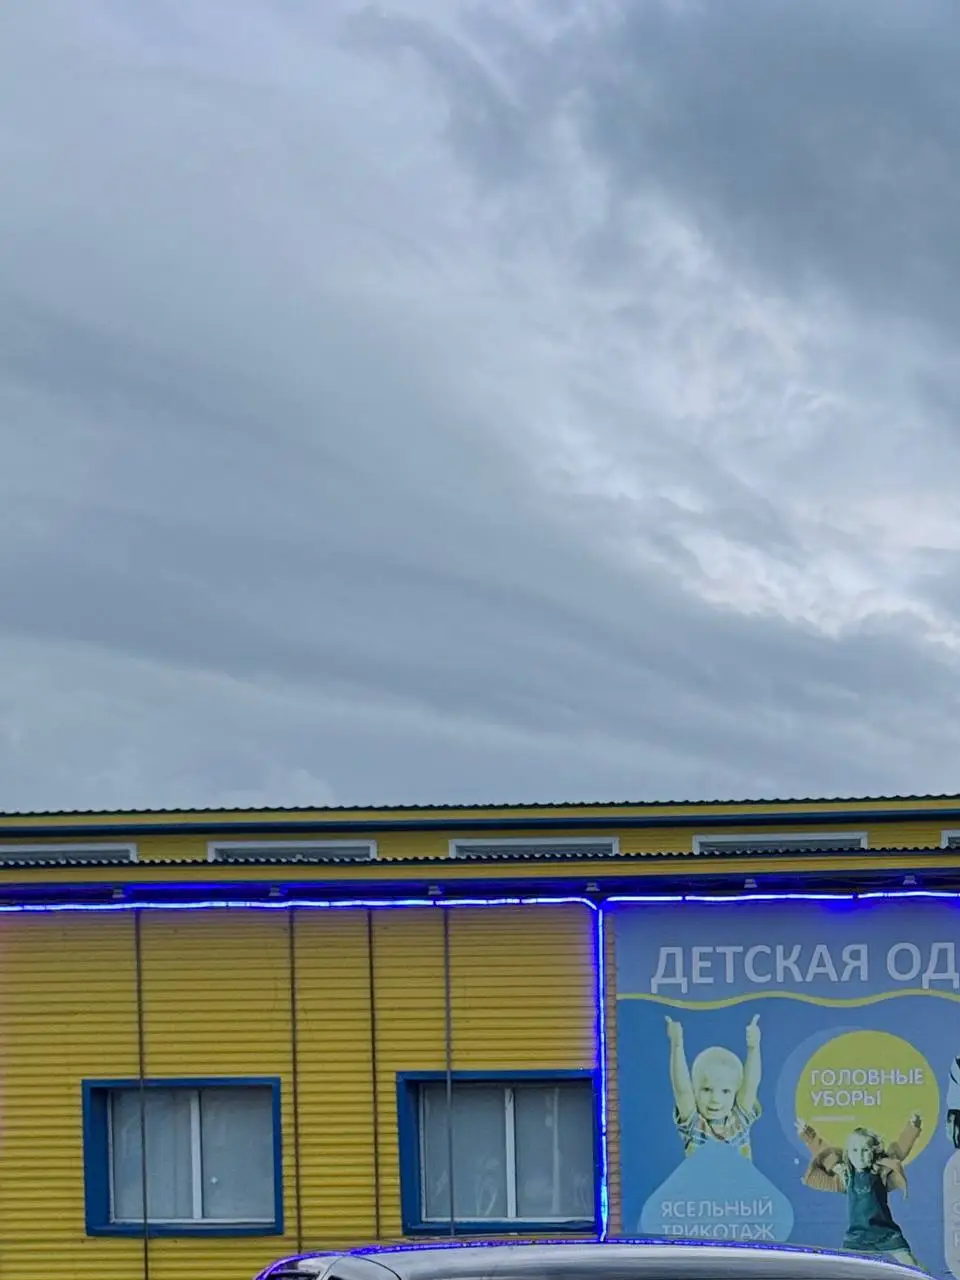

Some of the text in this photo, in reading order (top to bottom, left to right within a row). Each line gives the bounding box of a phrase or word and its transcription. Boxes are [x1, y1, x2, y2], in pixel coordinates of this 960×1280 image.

[650, 943, 868, 994] ДЕТСКАЯ
[811, 1068, 924, 1086] ГОЛОВНЫЕ
[811, 1090, 881, 1107] УБОРЫ
[661, 1196, 773, 1218] ЯСЕЛЬНЫЙ
[662, 1223, 776, 1240] ТРИКОТАЖ
